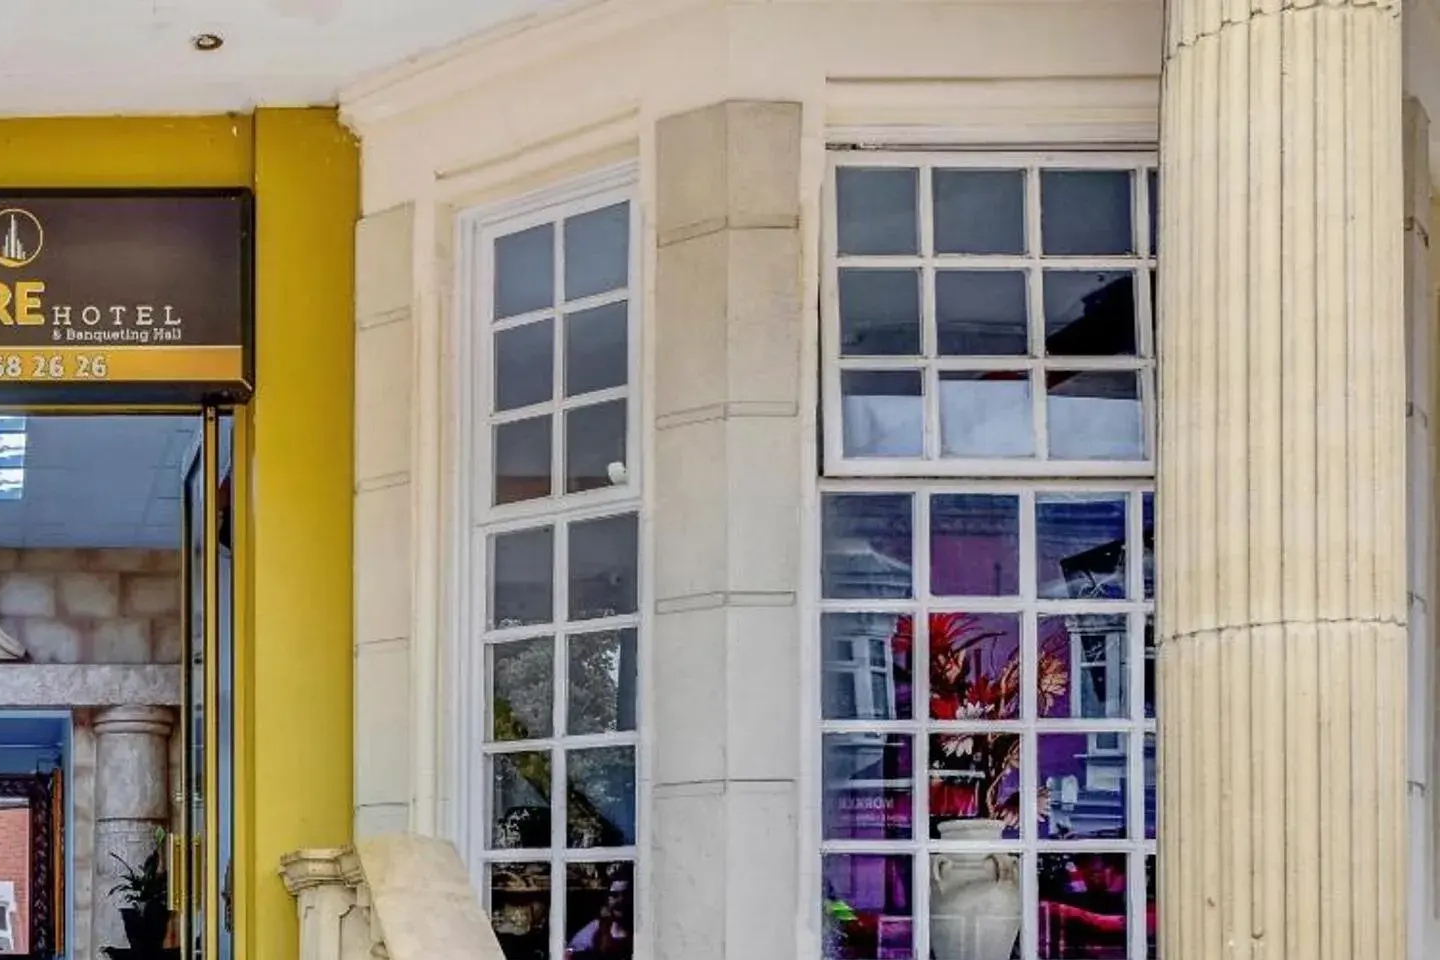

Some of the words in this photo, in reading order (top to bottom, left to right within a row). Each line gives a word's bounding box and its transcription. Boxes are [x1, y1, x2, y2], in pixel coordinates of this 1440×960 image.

[52, 305, 182, 326] HOTEL
[66, 328, 149, 342] Banqueting
[153, 328, 181, 341] Hall
[32, 355, 64, 378] 26
[75, 355, 108, 378] 26
